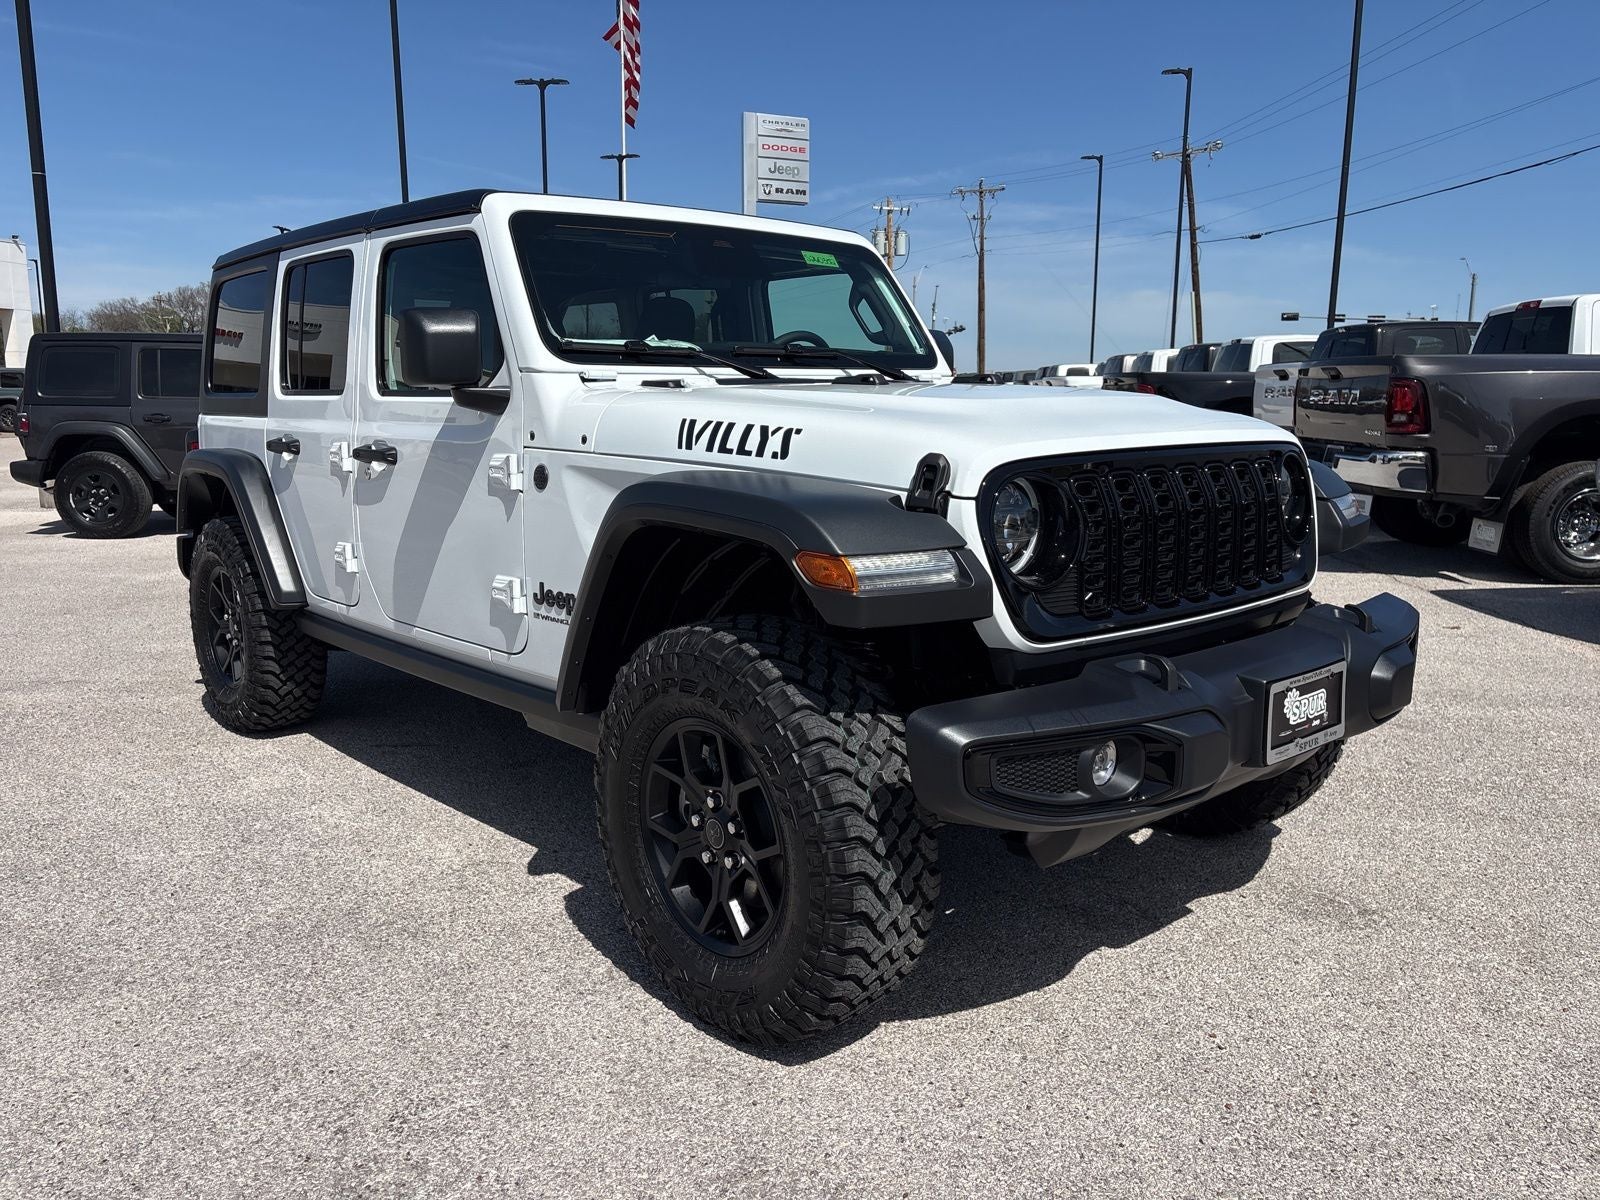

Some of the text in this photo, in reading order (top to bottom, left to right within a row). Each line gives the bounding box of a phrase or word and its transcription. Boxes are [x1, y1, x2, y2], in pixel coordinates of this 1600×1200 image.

[762, 119, 806, 128] CHRYSLER
[762, 143, 806, 154] DODGE
[768, 161, 800, 179] Jeep
[775, 187, 807, 196] RAM
[1309, 388, 1361, 406] RAM
[677, 417, 804, 461] WILLYS
[532, 581, 577, 616] Jeep
[1291, 690, 1326, 722] SPUR
[1298, 737, 1320, 752] SPUR
